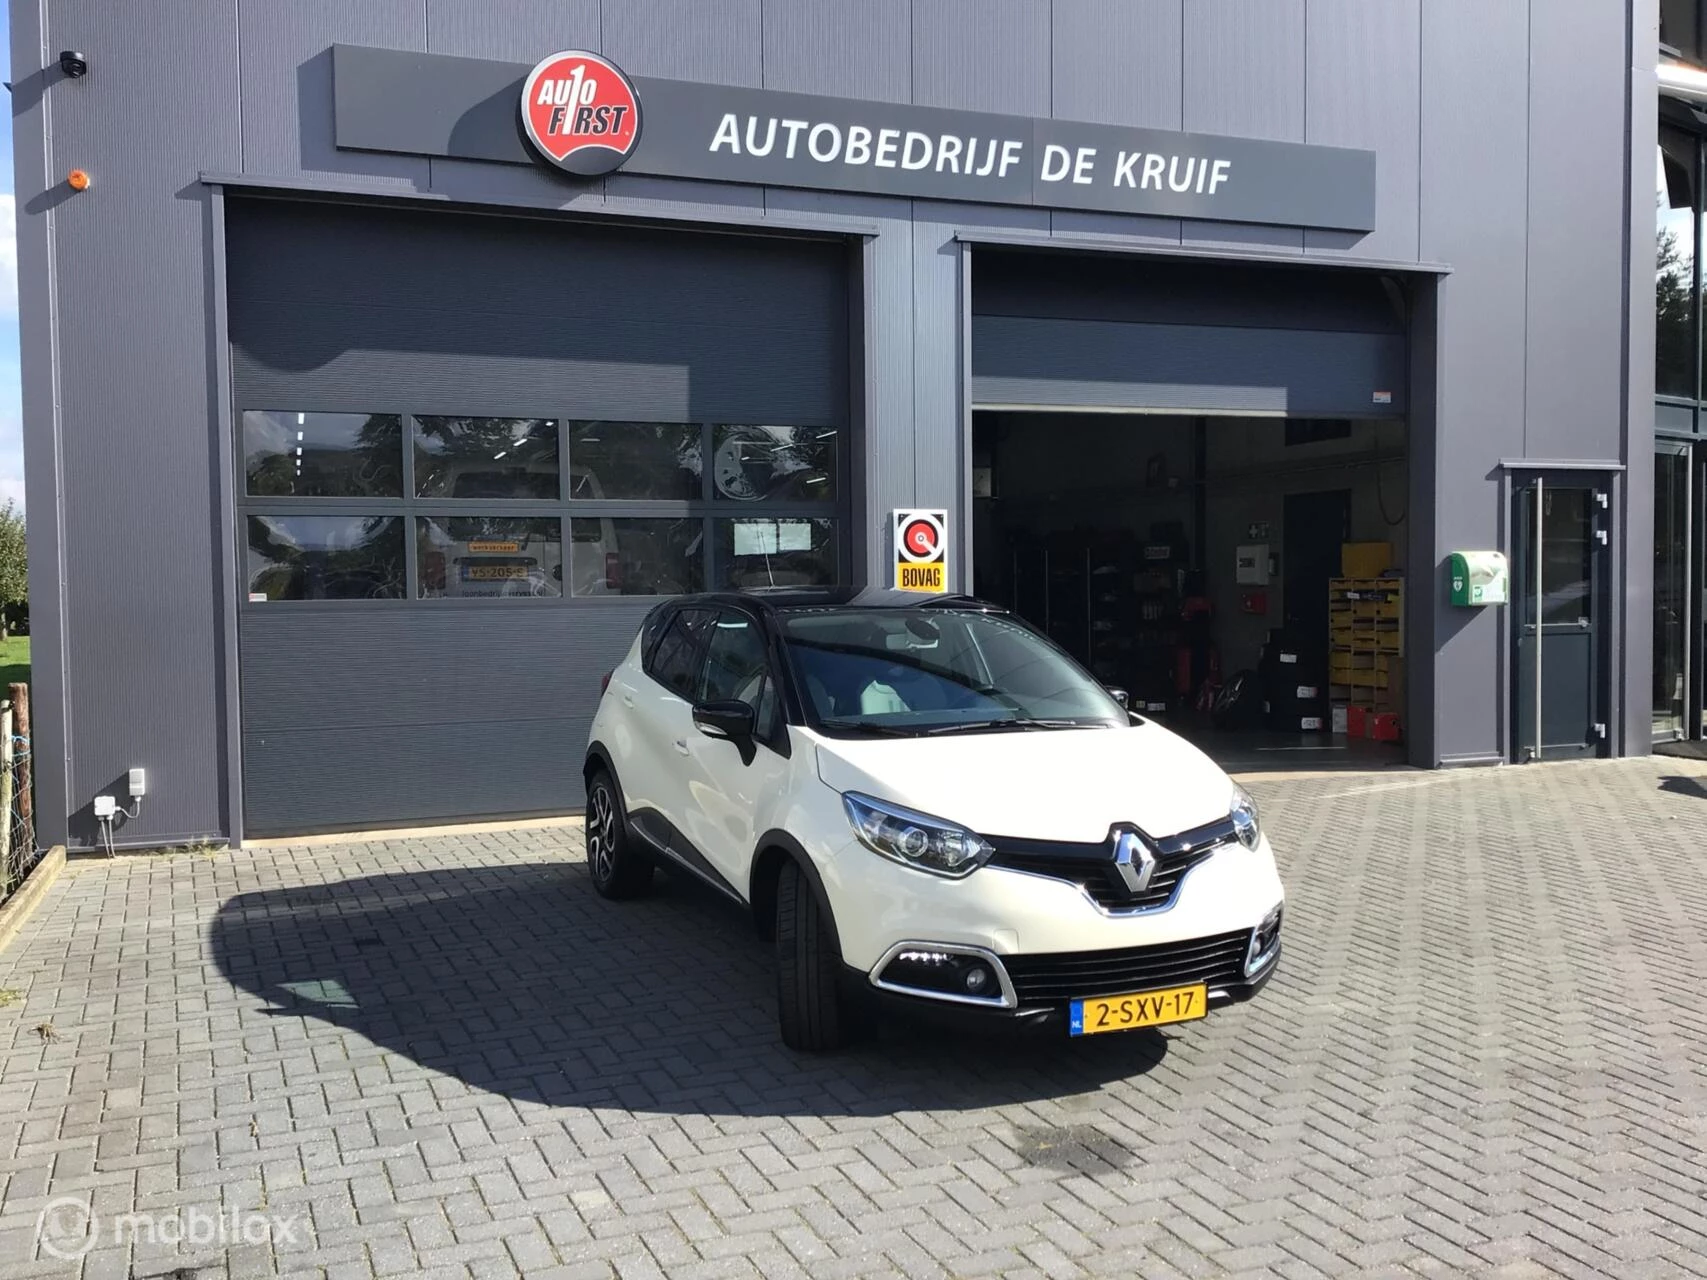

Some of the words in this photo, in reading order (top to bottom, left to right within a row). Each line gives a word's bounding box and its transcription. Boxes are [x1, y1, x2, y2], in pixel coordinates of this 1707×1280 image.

[709, 113, 1023, 178] AUTOBEDRIJF
[1040, 144, 1097, 185] DE
[1113, 151, 1231, 195] KRUIF
[902, 567, 941, 587] BOVAG
[1096, 991, 1195, 1027] 2-SXV-17
[1072, 1021, 1082, 1029] NL
